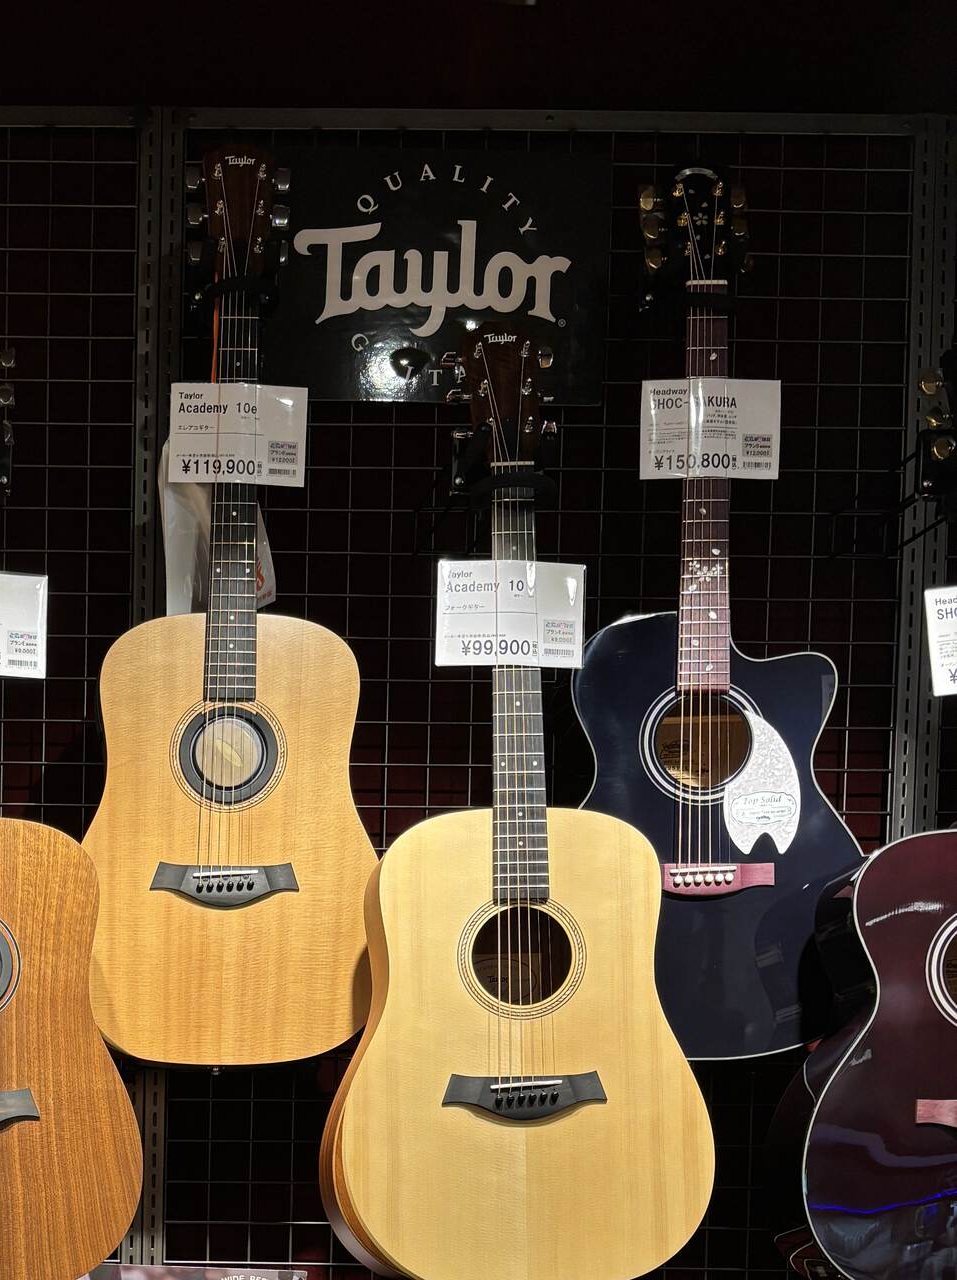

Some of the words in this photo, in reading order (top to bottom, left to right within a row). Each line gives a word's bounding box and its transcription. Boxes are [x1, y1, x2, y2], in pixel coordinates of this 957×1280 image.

[224, 155, 256, 167] Taylor
[357, 163, 538, 235] QUALITY
[293, 220, 572, 338] Taylor
[484, 332, 517, 344] Taylor
[179, 392, 203, 400] Taylor
[650, 388, 687, 396] Headway
[178, 402, 228, 414] Academy
[236, 402, 257, 414] 10e
[182, 459, 255, 475] ¥119,900
[445, 581, 499, 593] Academy
[461, 640, 530, 656] ¥99,900
